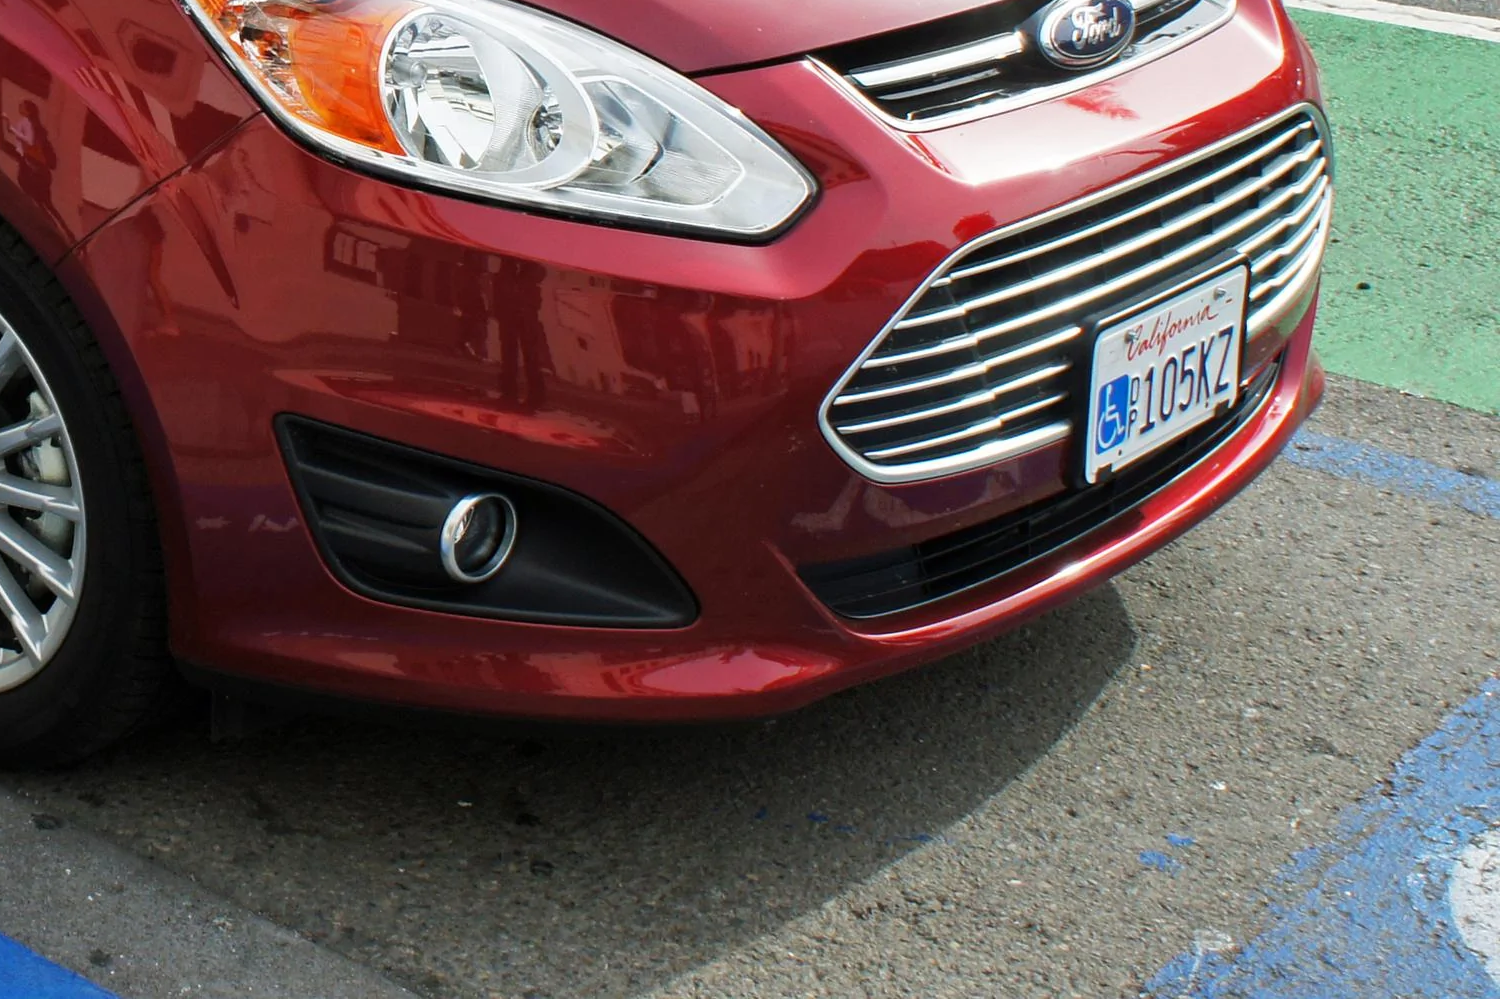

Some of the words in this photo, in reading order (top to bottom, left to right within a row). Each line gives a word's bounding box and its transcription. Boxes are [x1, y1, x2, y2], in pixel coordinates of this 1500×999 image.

[1071, 2, 1122, 50] Ford
[1126, 303, 1219, 361] California
[1139, 325, 1234, 435] 105KZ
